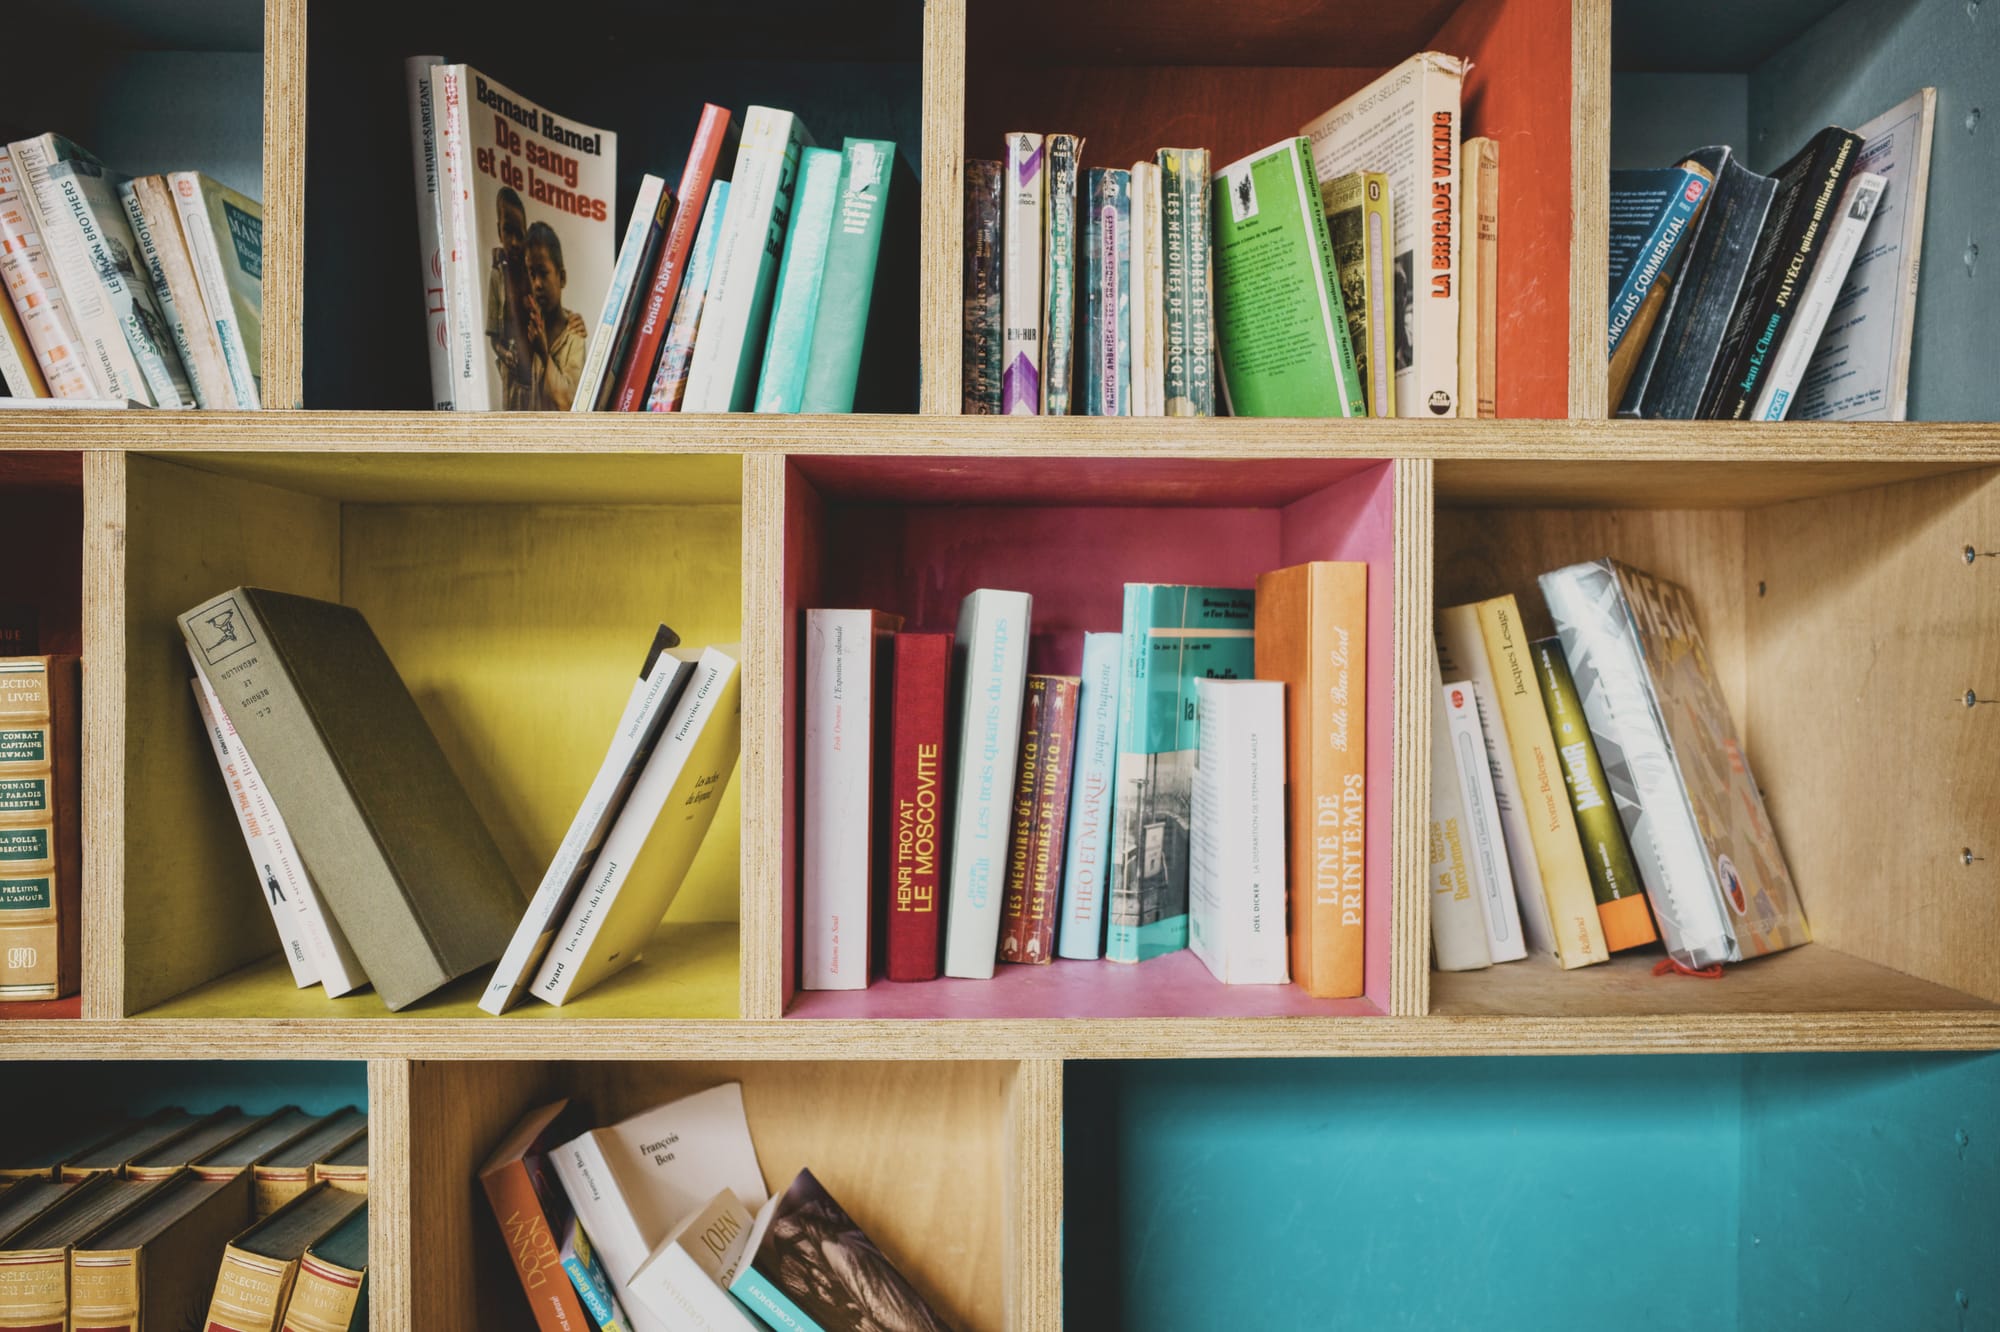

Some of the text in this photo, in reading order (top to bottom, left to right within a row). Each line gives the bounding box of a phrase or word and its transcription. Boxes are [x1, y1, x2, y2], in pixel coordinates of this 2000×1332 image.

[476, 76, 601, 156] Bernard Hamel
[494, 115, 578, 188] De sang
[1826, 137, 1853, 179] d'années
[477, 147, 607, 221] et de larmes
[1432, 111, 1452, 298] LA BRIGADE VIKING
[1809, 176, 1837, 222] milliards
[61, 179, 97, 242] BROTHERS
[1799, 219, 1820, 254] quinze
[91, 242, 122, 294] LEHMAN
[128, 198, 172, 303] LEHMAN BROTHERS
[1635, 215, 1687, 292] COMMERCIAL
[1782, 251, 1806, 286] VÉCU
[641, 260, 674, 335] Denise Fabre
[1167, 192, 1183, 387] LES MEMOIRES DE VIDOCQ 2
[1190, 192, 1206, 387] LES MEMOIRES DE VIDOCQ 2
[1739, 364, 1759, 393] Jean
[1333, 626, 1350, 708] Bao Lord
[1498, 609, 1527, 696] Jacques Lesage
[8, 692, 41, 702] LIVRE
[674, 667, 718, 742] Françoise Giroud
[1, 741, 42, 749] CAPITAINE
[975, 618, 1007, 840] Les trois quarts du temps
[1094, 724, 1108, 765] Jacques
[237, 744, 256, 777] Rome
[249, 775, 263, 792] de
[1021, 742, 1037, 793] VIDOCQ
[1044, 745, 1062, 796] VIDOCQ
[255, 792, 271, 824] chute
[1019, 799, 1031, 815] DE
[1041, 802, 1053, 818] DE
[1084, 772, 1107, 838] MARIE
[1532, 746, 1560, 832] Yvonne Bellenger
[271, 836, 284, 855] sur
[914, 744, 937, 912] LE MOSCOVITE
[1082, 839, 1099, 863] ET
[1317, 795, 1339, 906] LUNE DE
[1341, 773, 1363, 926] PRINTEMPS
[897, 799, 915, 912] HENRI TROYAT
[1010, 820, 1028, 889] MEMOIRES
[1033, 823, 1052, 891] MEMOIRES
[6, 894, 43, 902] L'AMOUR
[294, 897, 307, 913] Le
[565, 861, 618, 952] Les taches du léopard
[1009, 894, 1021, 917] LES
[1031, 896, 1044, 919] LES
[545, 962, 565, 992] fayard
[640, 1132, 680, 1156] François
[654, 1152, 675, 1166] Bon
[507, 1210, 546, 1289] DONNA
[529, 1215, 559, 1269] LEON
[701, 1210, 742, 1265] JOHN
[2, 1286, 18, 1296] DU
[220, 1284, 271, 1308] DU LIVRE
[223, 1271, 275, 1294] SELECTION
[568, 1263, 608, 1321] Spécial Brevet
